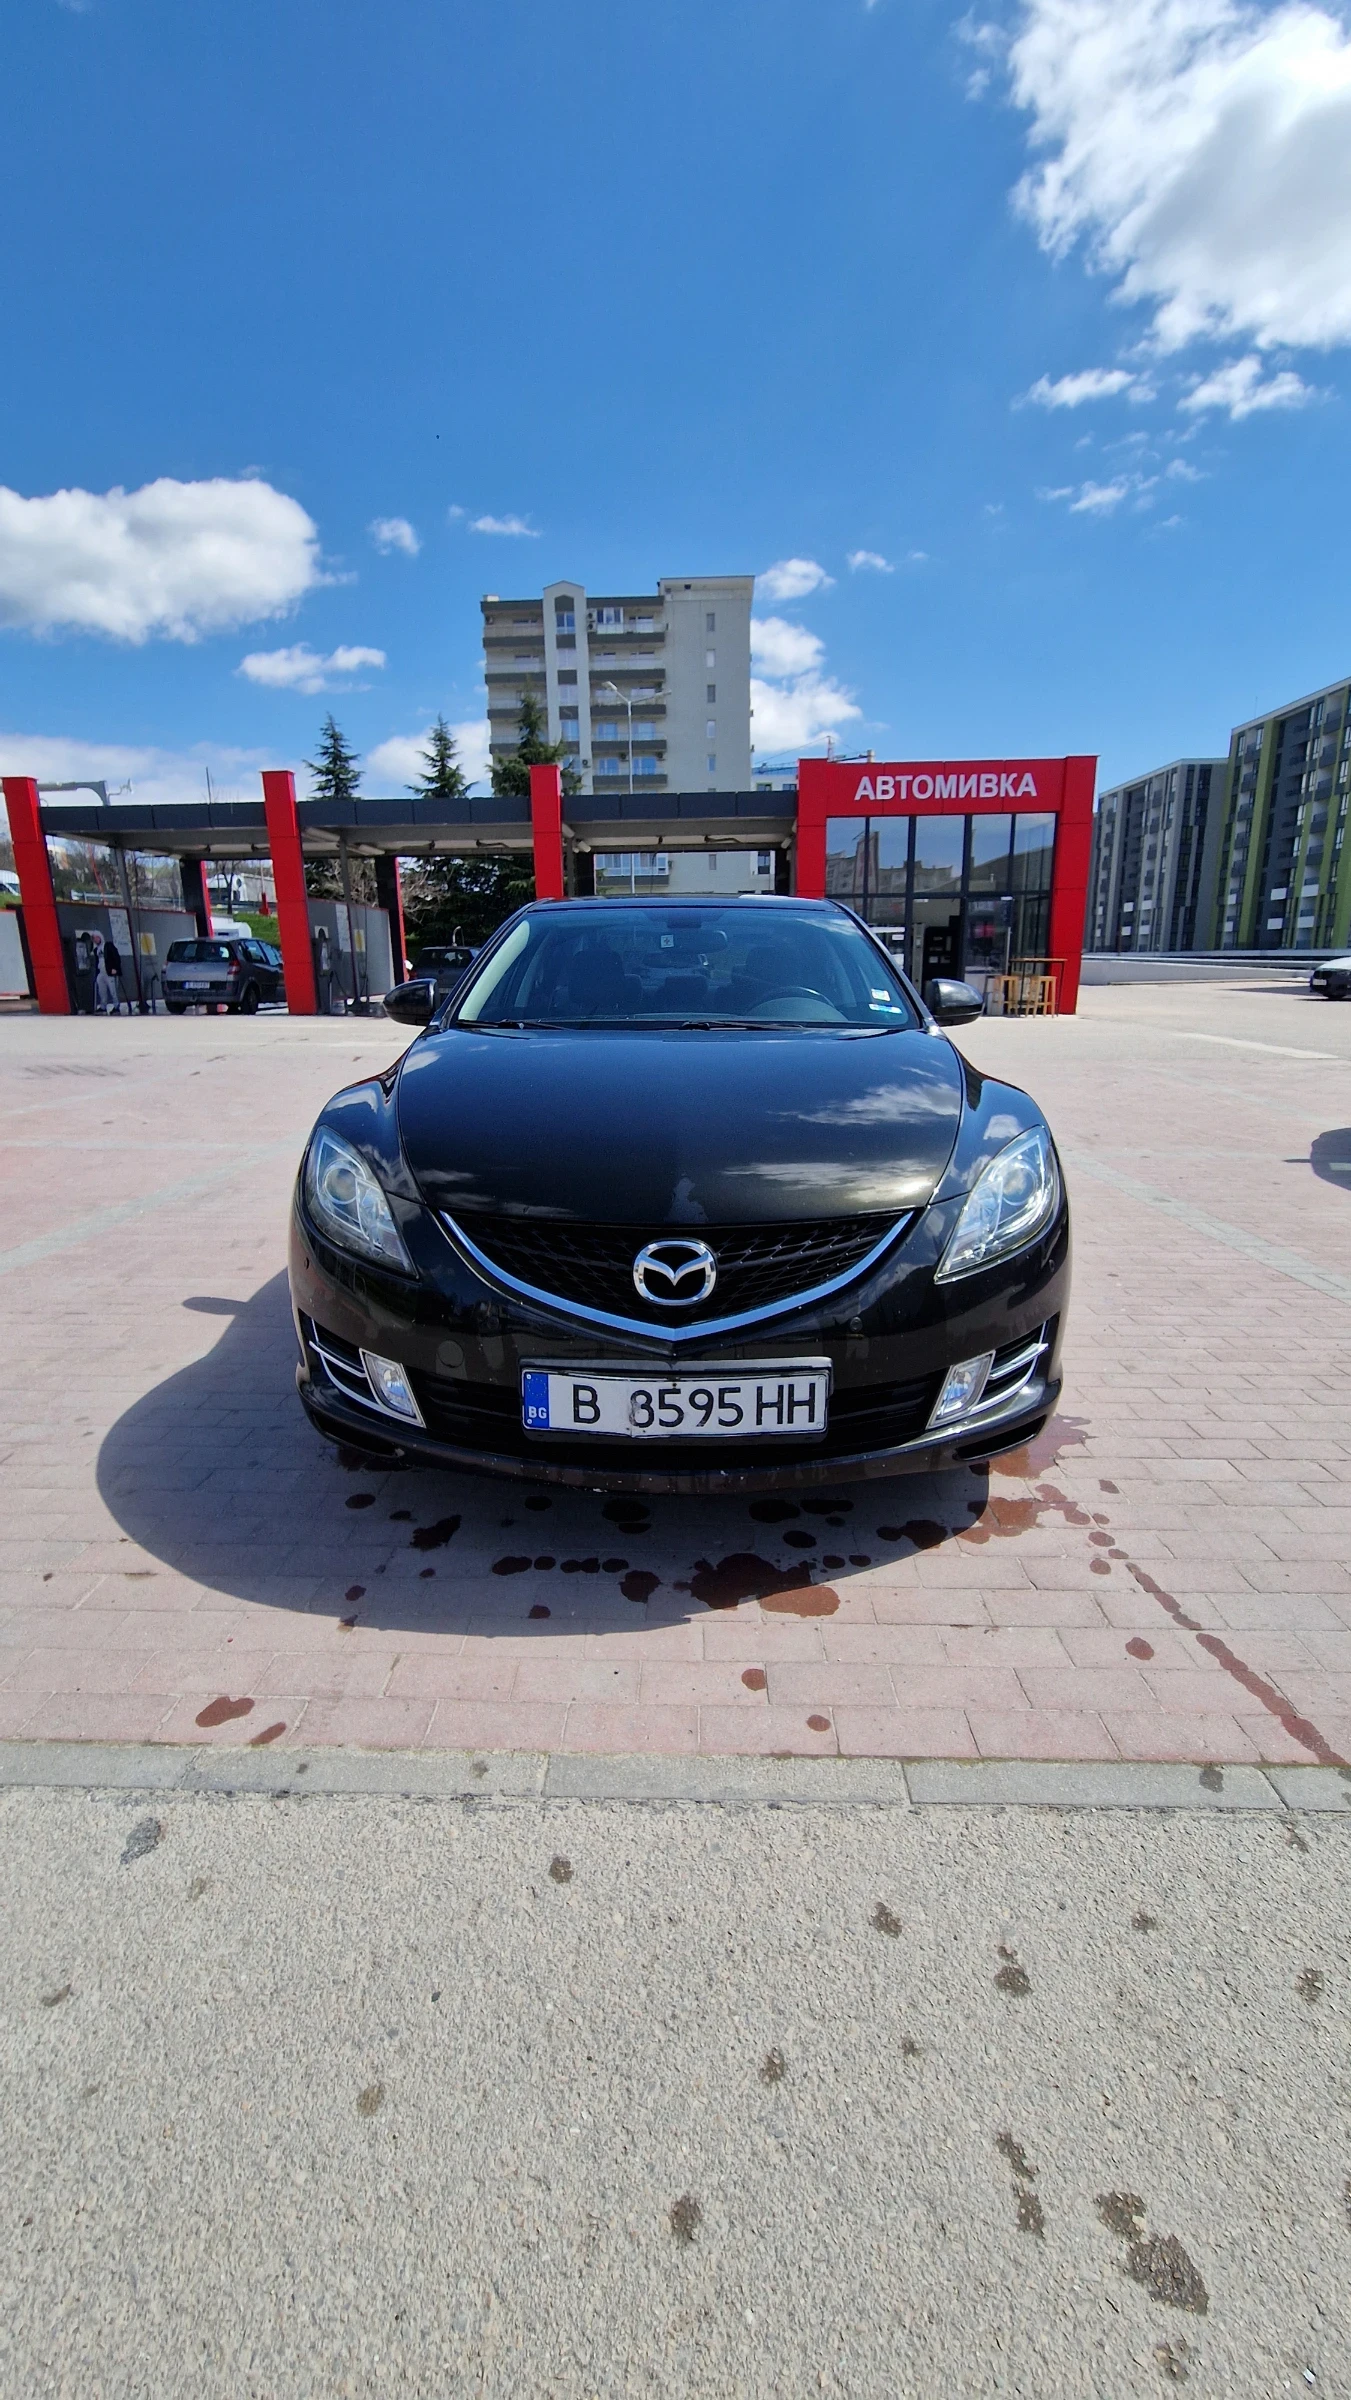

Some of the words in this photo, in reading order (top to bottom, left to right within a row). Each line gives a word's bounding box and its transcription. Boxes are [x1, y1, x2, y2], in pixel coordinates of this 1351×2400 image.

[854, 772, 1037, 801] АВТОМИВКА
[528, 1406, 547, 1419] BG
[572, 1384, 601, 1424] B
[629, 1387, 744, 1428] 8595
[756, 1382, 816, 1426] HH
